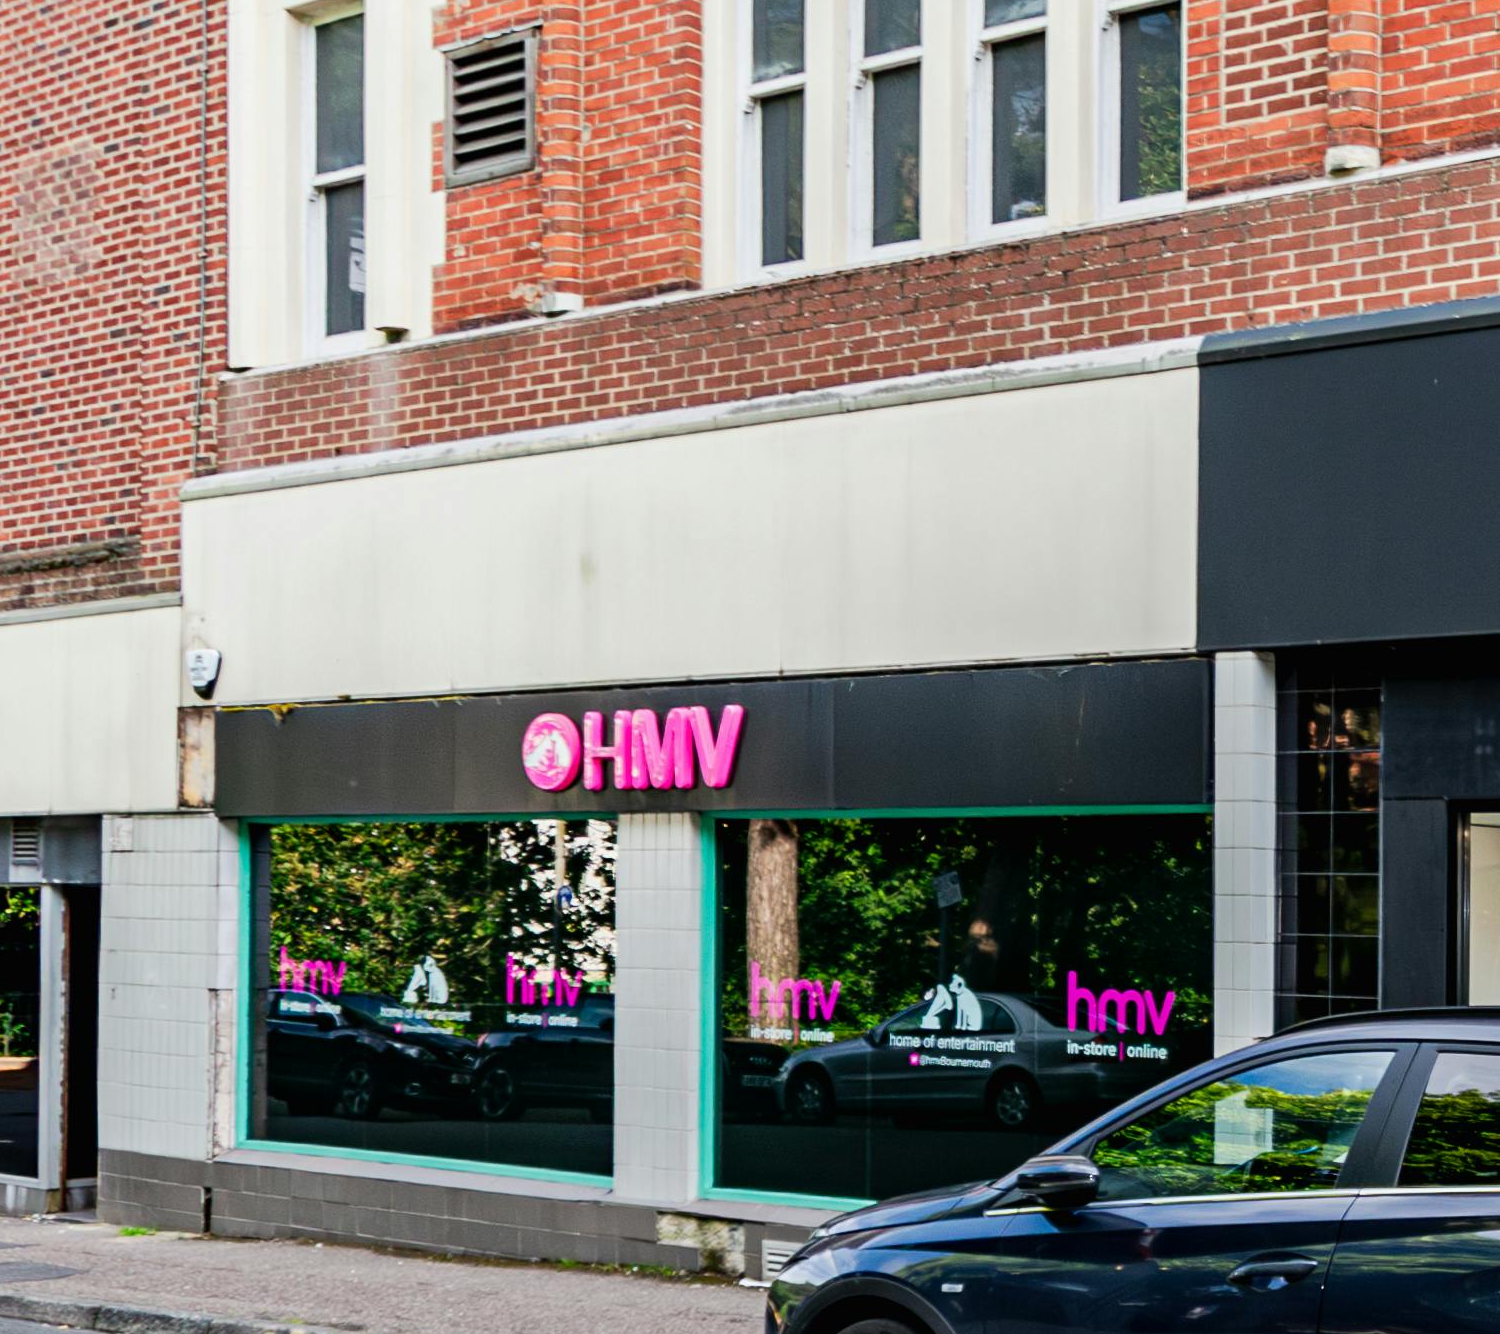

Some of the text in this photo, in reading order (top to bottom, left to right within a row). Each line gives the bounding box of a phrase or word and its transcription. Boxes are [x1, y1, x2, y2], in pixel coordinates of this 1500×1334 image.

[583, 704, 744, 790] HMV
[279, 945, 346, 995] hmv
[506, 951, 584, 1007] hmv
[750, 960, 842, 1020] hmv
[1067, 970, 1176, 1036] hmv
[750, 1025, 834, 1043] in-store online
[889, 1033, 1016, 1053] home of entertainment
[1067, 1040, 1168, 1059] in-store online
